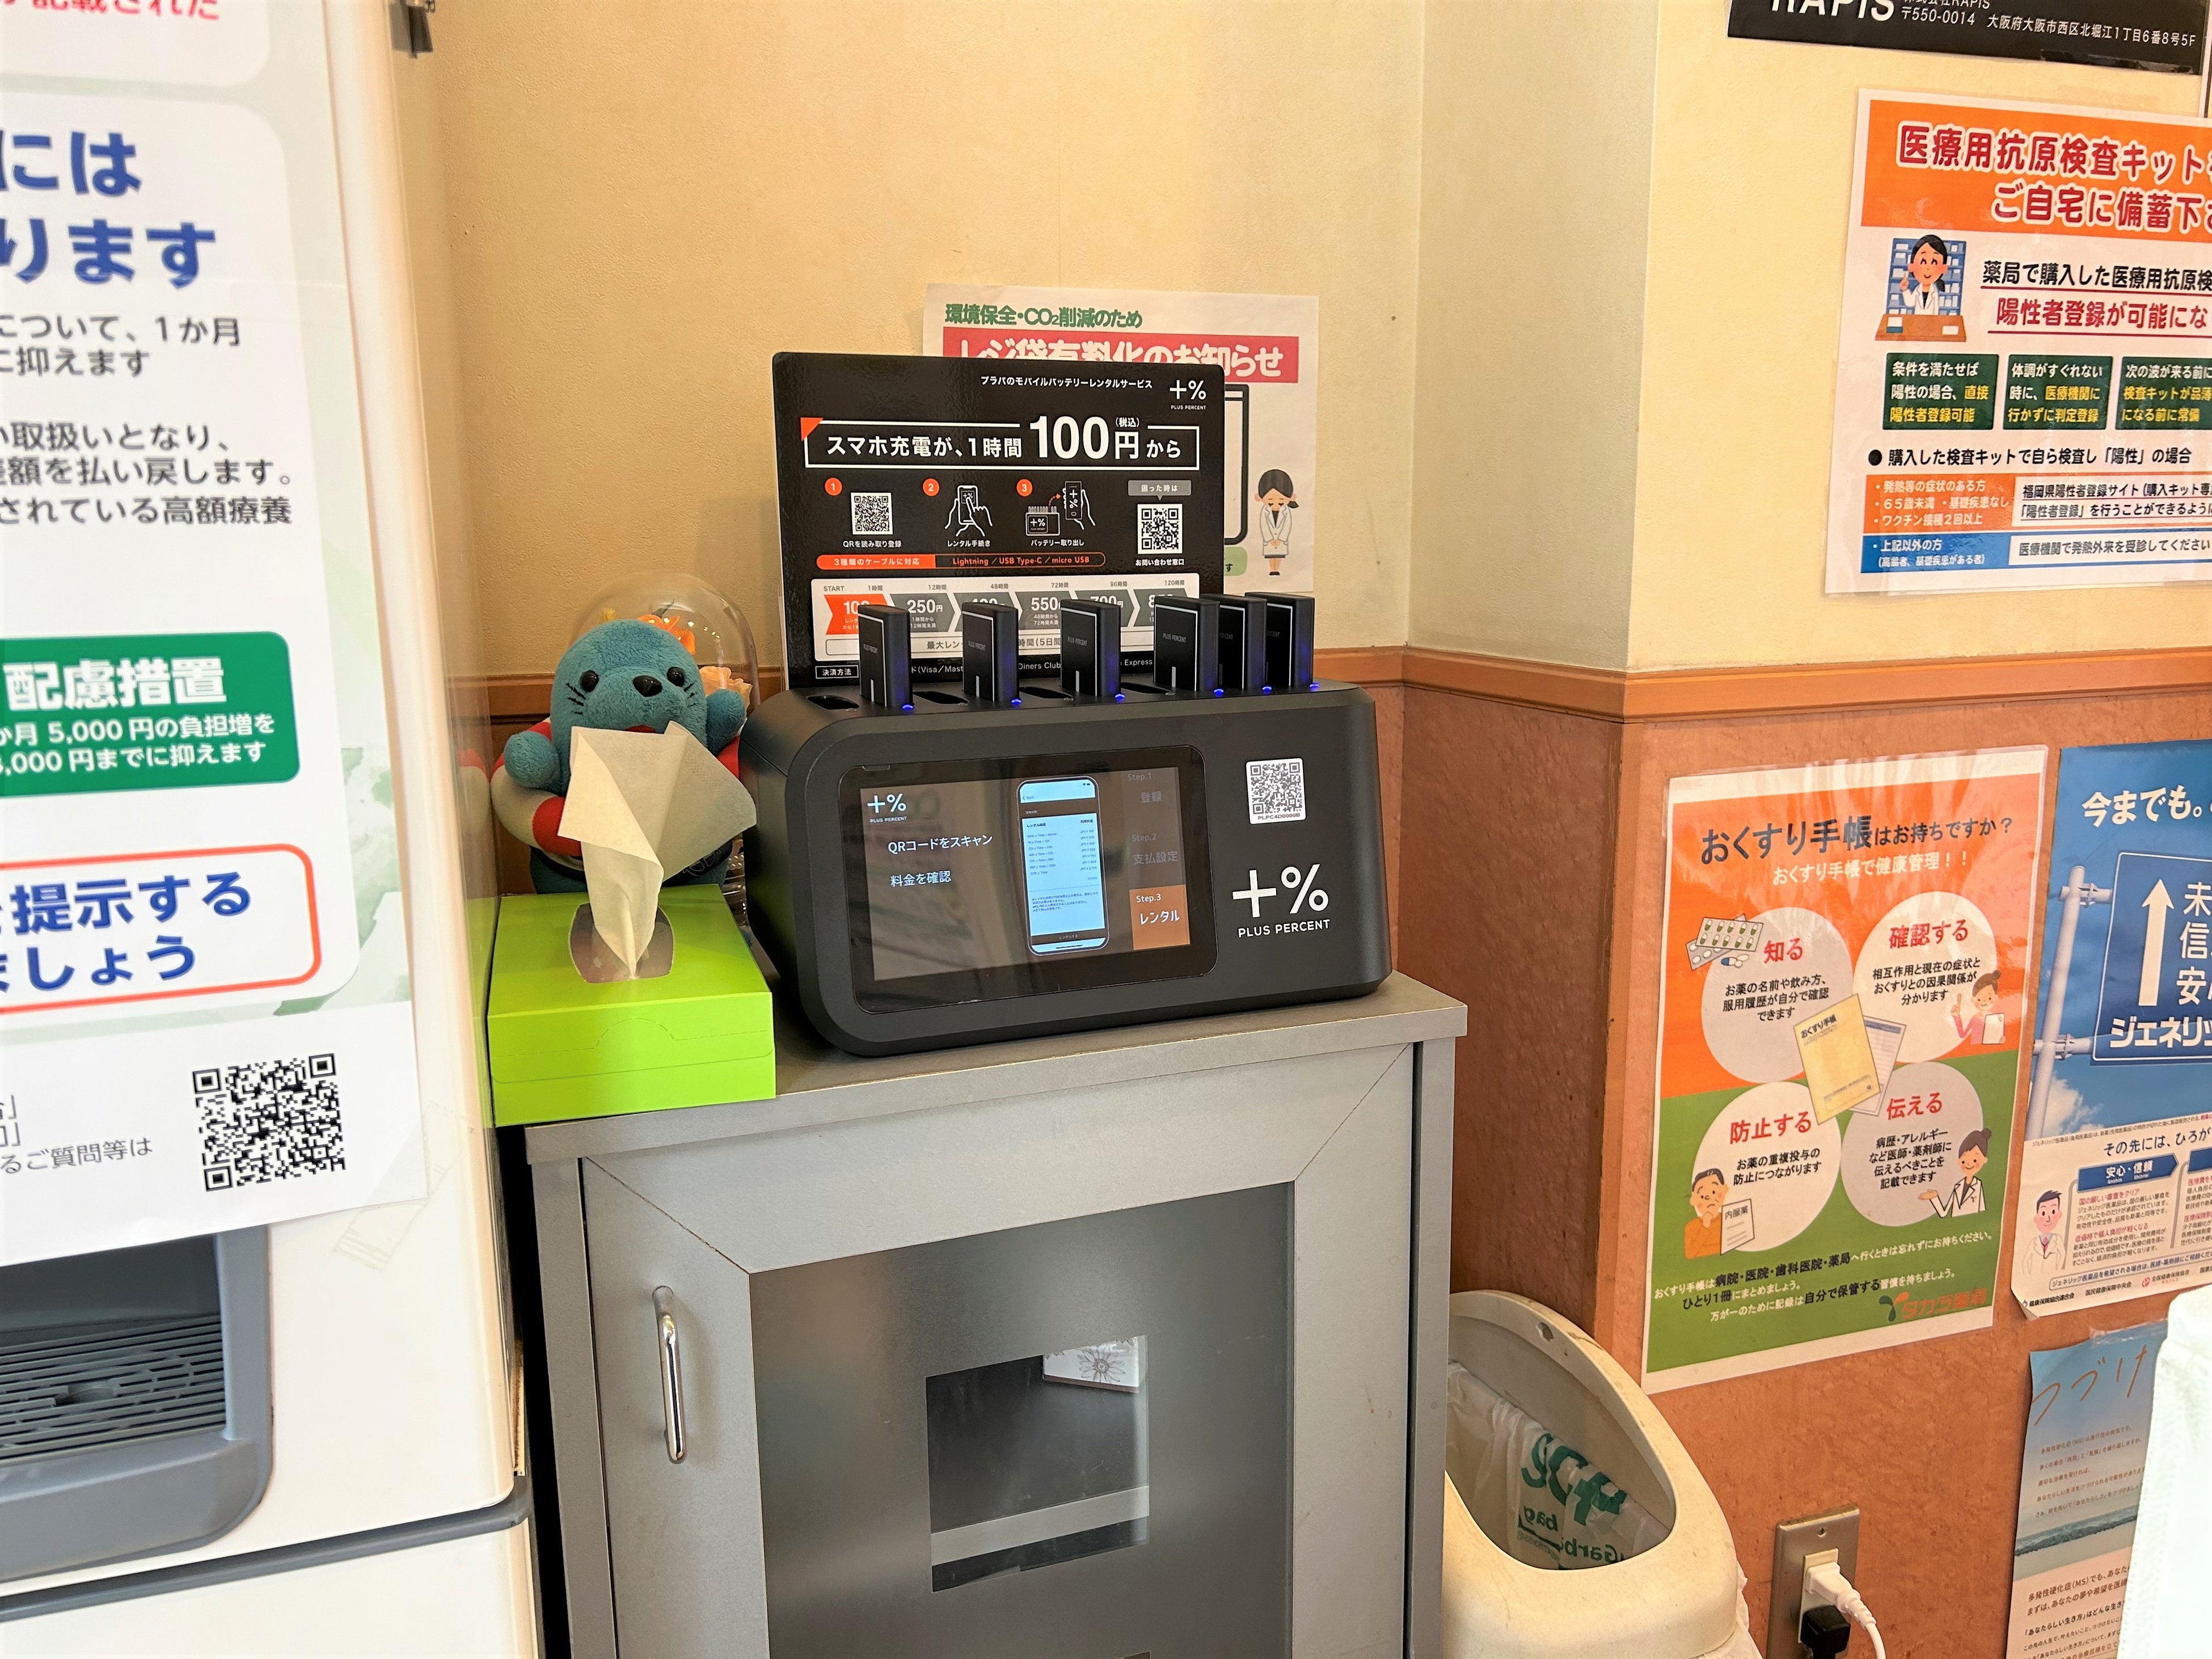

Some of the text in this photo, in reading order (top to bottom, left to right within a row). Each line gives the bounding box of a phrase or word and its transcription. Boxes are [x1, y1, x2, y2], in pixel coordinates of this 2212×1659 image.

[1987, 14, 2196, 47] 大阪府大阪市西区北堀江1丁目6番8号5F
[1899, 124, 2212, 181] 医療用抗原検査キット
[1994, 183, 2212, 230] ご自宅に備蓄下
[1983, 260, 2212, 291] 薬局で購入した医療用抗原検
[1996, 297, 2212, 329] 陽性者登録が可能にな
[1892, 361, 1979, 377] 条件を満たせば
[2012, 363, 2103, 378] 体調がすぐれない
[2125, 364, 2212, 379] 次の波が来る前に
[2124, 386, 2212, 401] 検査キットが品薄
[1890, 408, 1975, 423] 陽性者登録可能
[2008, 408, 2099, 423] 行かずに判定登録
[2122, 408, 2200, 423] になる前に常備
[2023, 483, 2212, 499] 福岡県陽性者登録サイト(購入キット専
[0, 495, 293, 525] されている高額療養
[1031, 538, 1084, 547] バッテリー取り出し
[2019, 538, 2210, 555] 医療機関で発熱外来を受診してください
[952, 558, 989, 567] Lightning
[1135, 558, 1184, 567] お問い合わせ窓口
[907, 599, 943, 614] 250円
[1031, 596, 1061, 611] 550
[927, 641, 963, 649] 最大レン
[2, 657, 227, 711] 配慮措置
[0, 752, 64, 776] ,000
[1128, 772, 1152, 781] Step.1
[1140, 791, 1162, 803] 登録
[2082, 784, 2212, 828] 今までも。
[888, 834, 993, 855] QRコードをスキャン
[1132, 833, 1157, 842] Step.2
[1133, 851, 1178, 865] 支払設定
[890, 870, 952, 887] 料金を確認
[0, 871, 252, 936] 提示する
[1136, 894, 1162, 903] Step.3
[1140, 910, 1180, 925] レンタル
[1238, 919, 1330, 938] PLUS PERCENT
[1889, 919, 1969, 949] 確認する
[1763, 937, 1804, 963] 知る
[2180, 921, 2212, 960] 信
[1872, 957, 1981, 980] 相互作用と現在の症状と
[1725, 973, 1827, 997] お薬の名前や飲み方、
[1874, 972, 1977, 995] おくすりとの因果関係が
[2176, 965, 2212, 1005] 安
[1723, 987, 1829, 1013] 服用履歴が自分で確認
[1901, 989, 1949, 1006] 分かります
[1757, 1006, 1795, 1021] できます
[1886, 1092, 1943, 1120] 伝える
[1730, 1111, 1813, 1145] 防止する
[1876, 1129, 1949, 1149] 病歴・アレルギー
[0, 1137, 153, 1174] るご質問等は
[1737, 1147, 1821, 1171] お薬の重複投与の
[1868, 1140, 1952, 1164] など医師・薬剤師に
[1733, 1160, 1822, 1186] 防止につながります
[1874, 1156, 1945, 1177] 伝えるべきことを
[1880, 1171, 1937, 1190] 記載できます
[1725, 1205, 1749, 1220] 内服薬
[1902, 1287, 1987, 1320] タカラ薬局
[2028, 1564, 2130, 1602] 多発性硬化症(MS)でも、あなた
